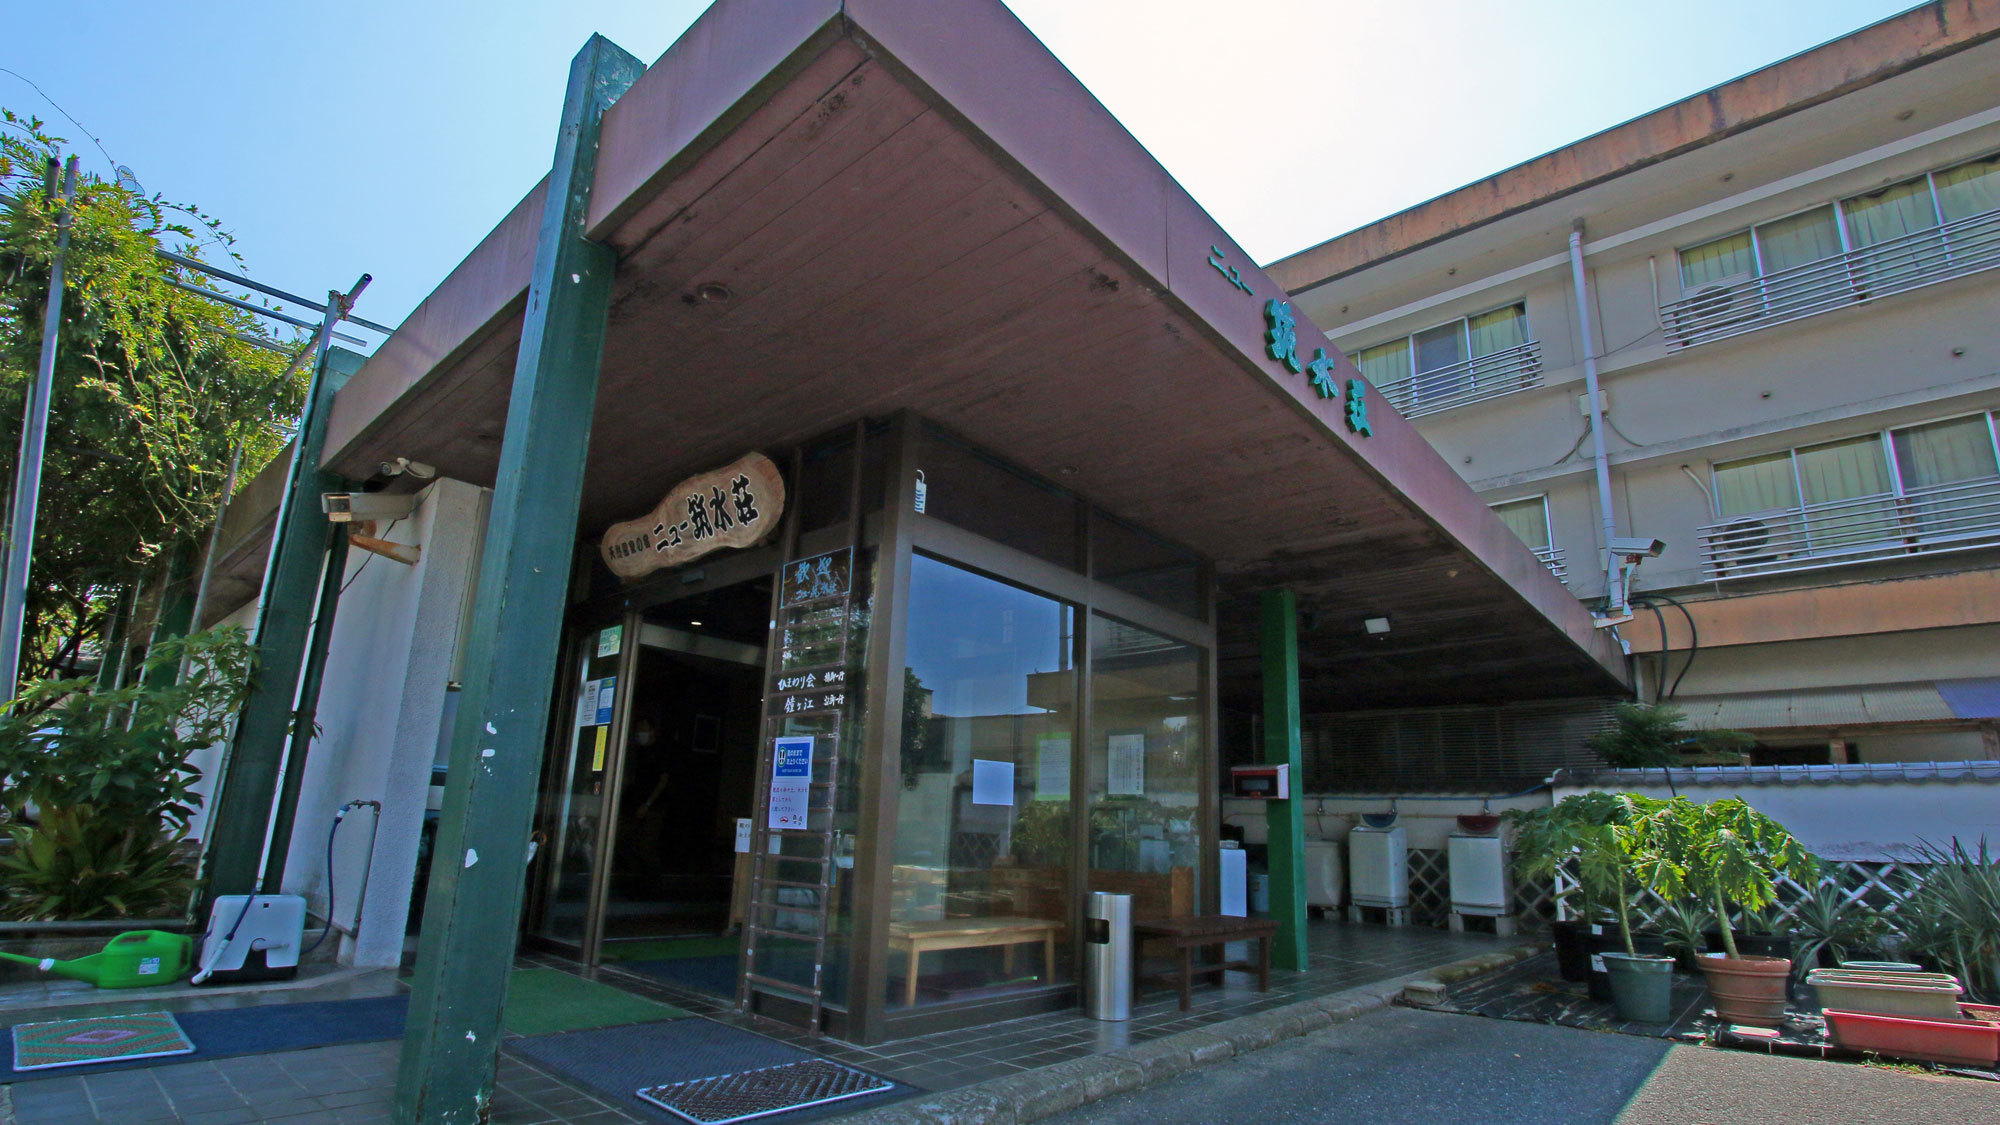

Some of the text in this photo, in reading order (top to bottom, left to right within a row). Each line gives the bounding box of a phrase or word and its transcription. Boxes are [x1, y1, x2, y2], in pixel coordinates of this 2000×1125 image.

[778, 672, 817, 691] ひまわり会
